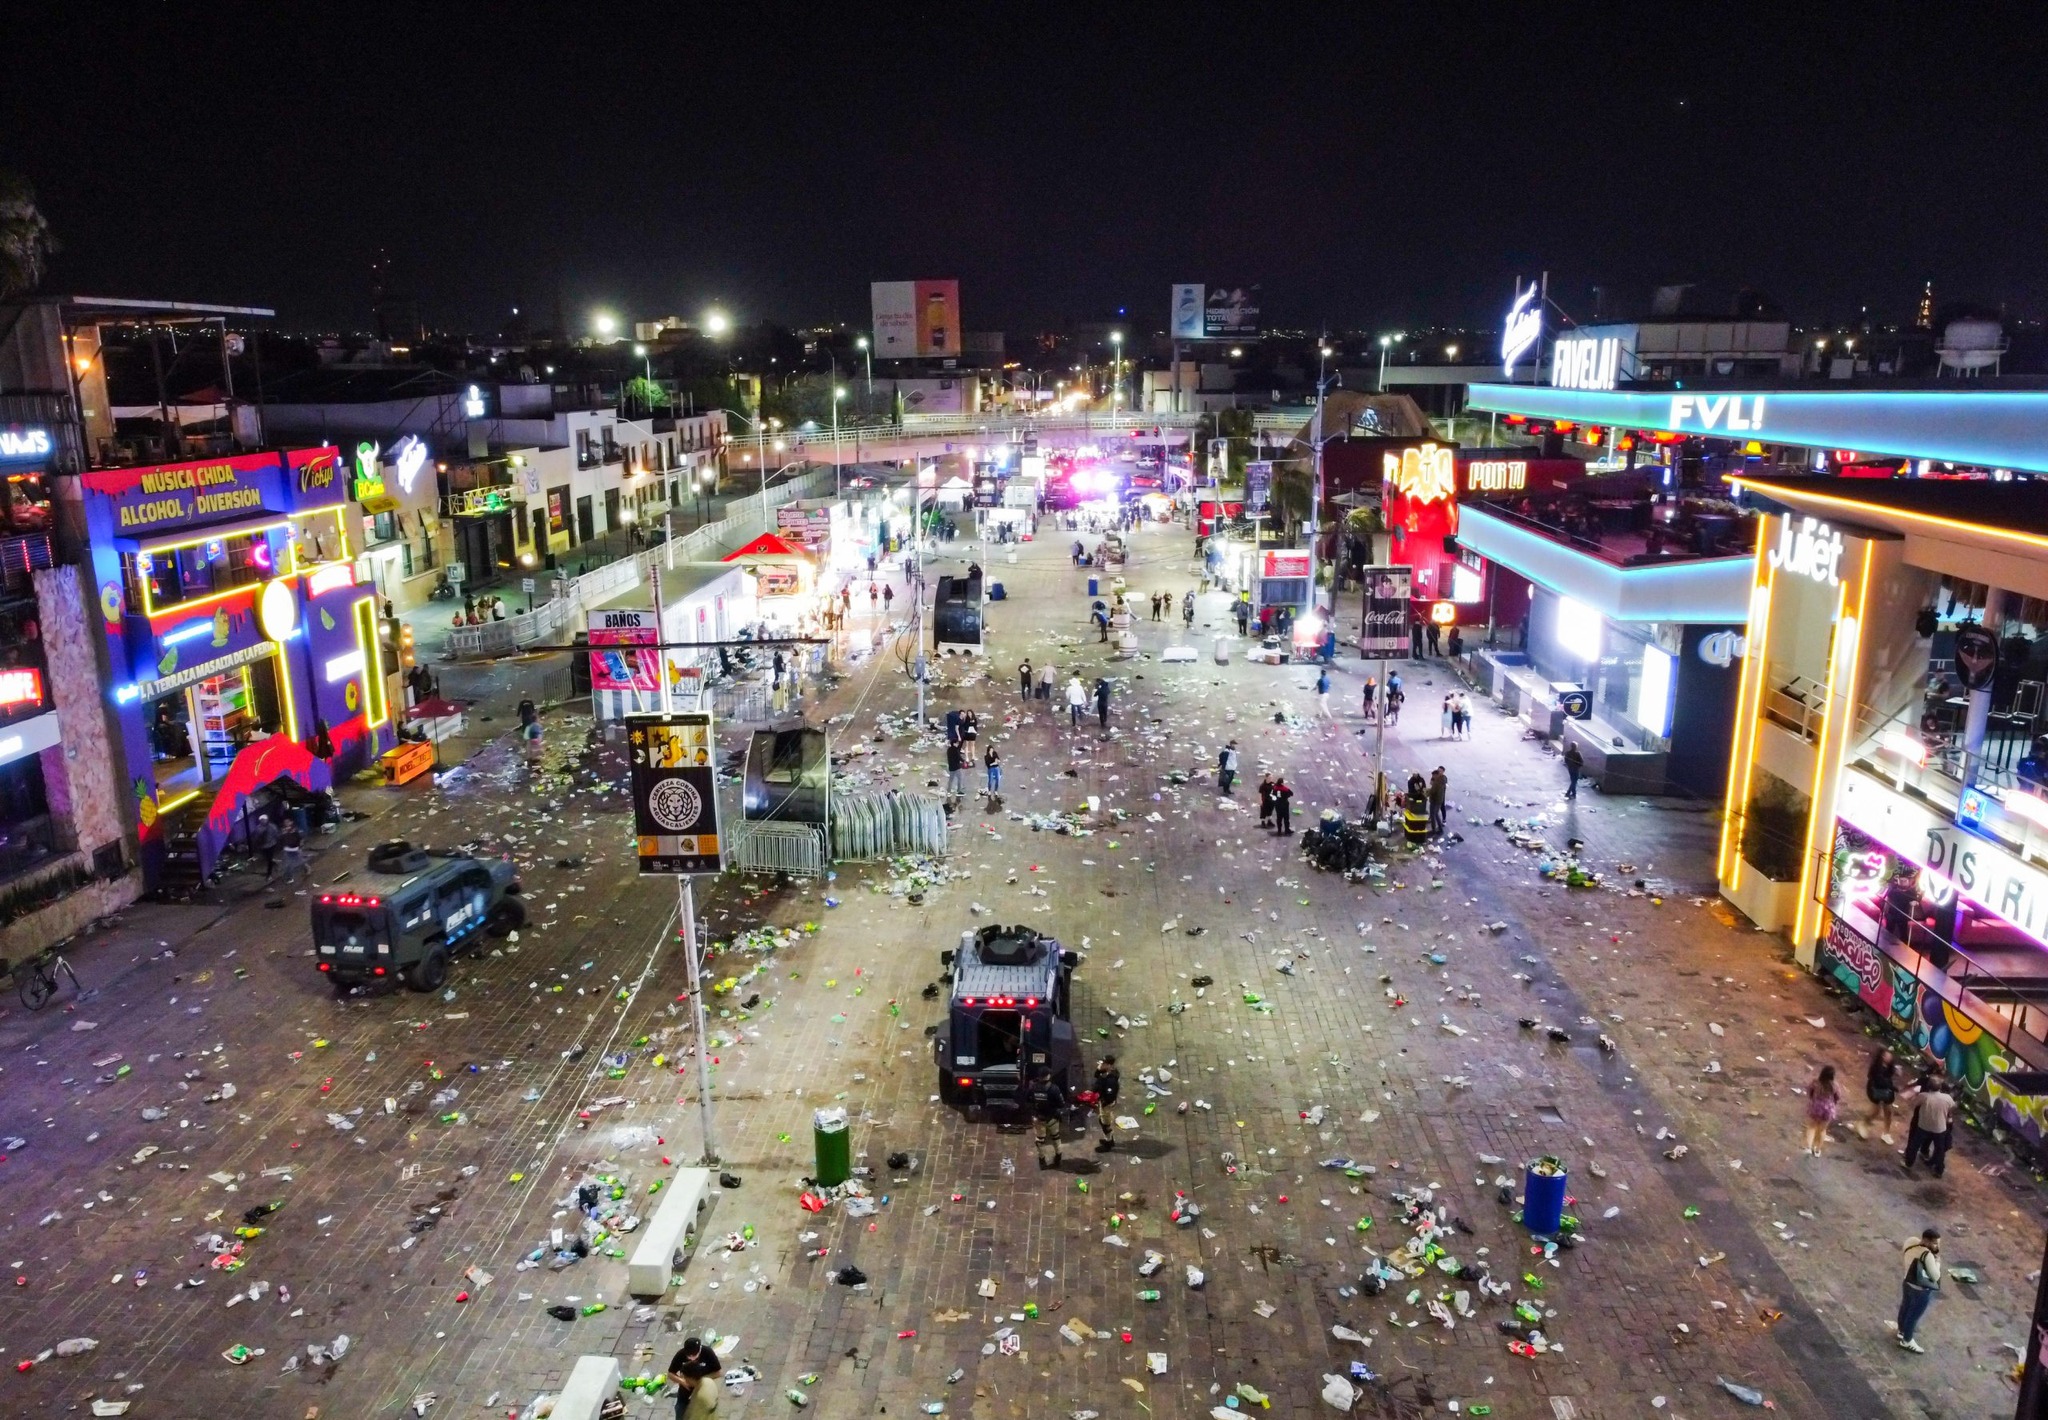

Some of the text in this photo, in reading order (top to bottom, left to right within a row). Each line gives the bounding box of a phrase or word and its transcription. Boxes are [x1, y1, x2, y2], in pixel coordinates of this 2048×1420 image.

[1552, 338, 1618, 390] FAVELA!
[1668, 395, 1765, 431] FVL!
[141, 468, 196, 495] MÚSICA
[121, 485, 261, 527] ALCOHOL y DIVERSIÓN
[604, 610, 641, 628] BAÑOS
[140, 641, 276, 699] LA TERRAZA MAS ALTA DE LA FERIA
[651, 780, 698, 802] CERVEZA CORONA
[652, 804, 699, 829] AGUASCALIENTES
